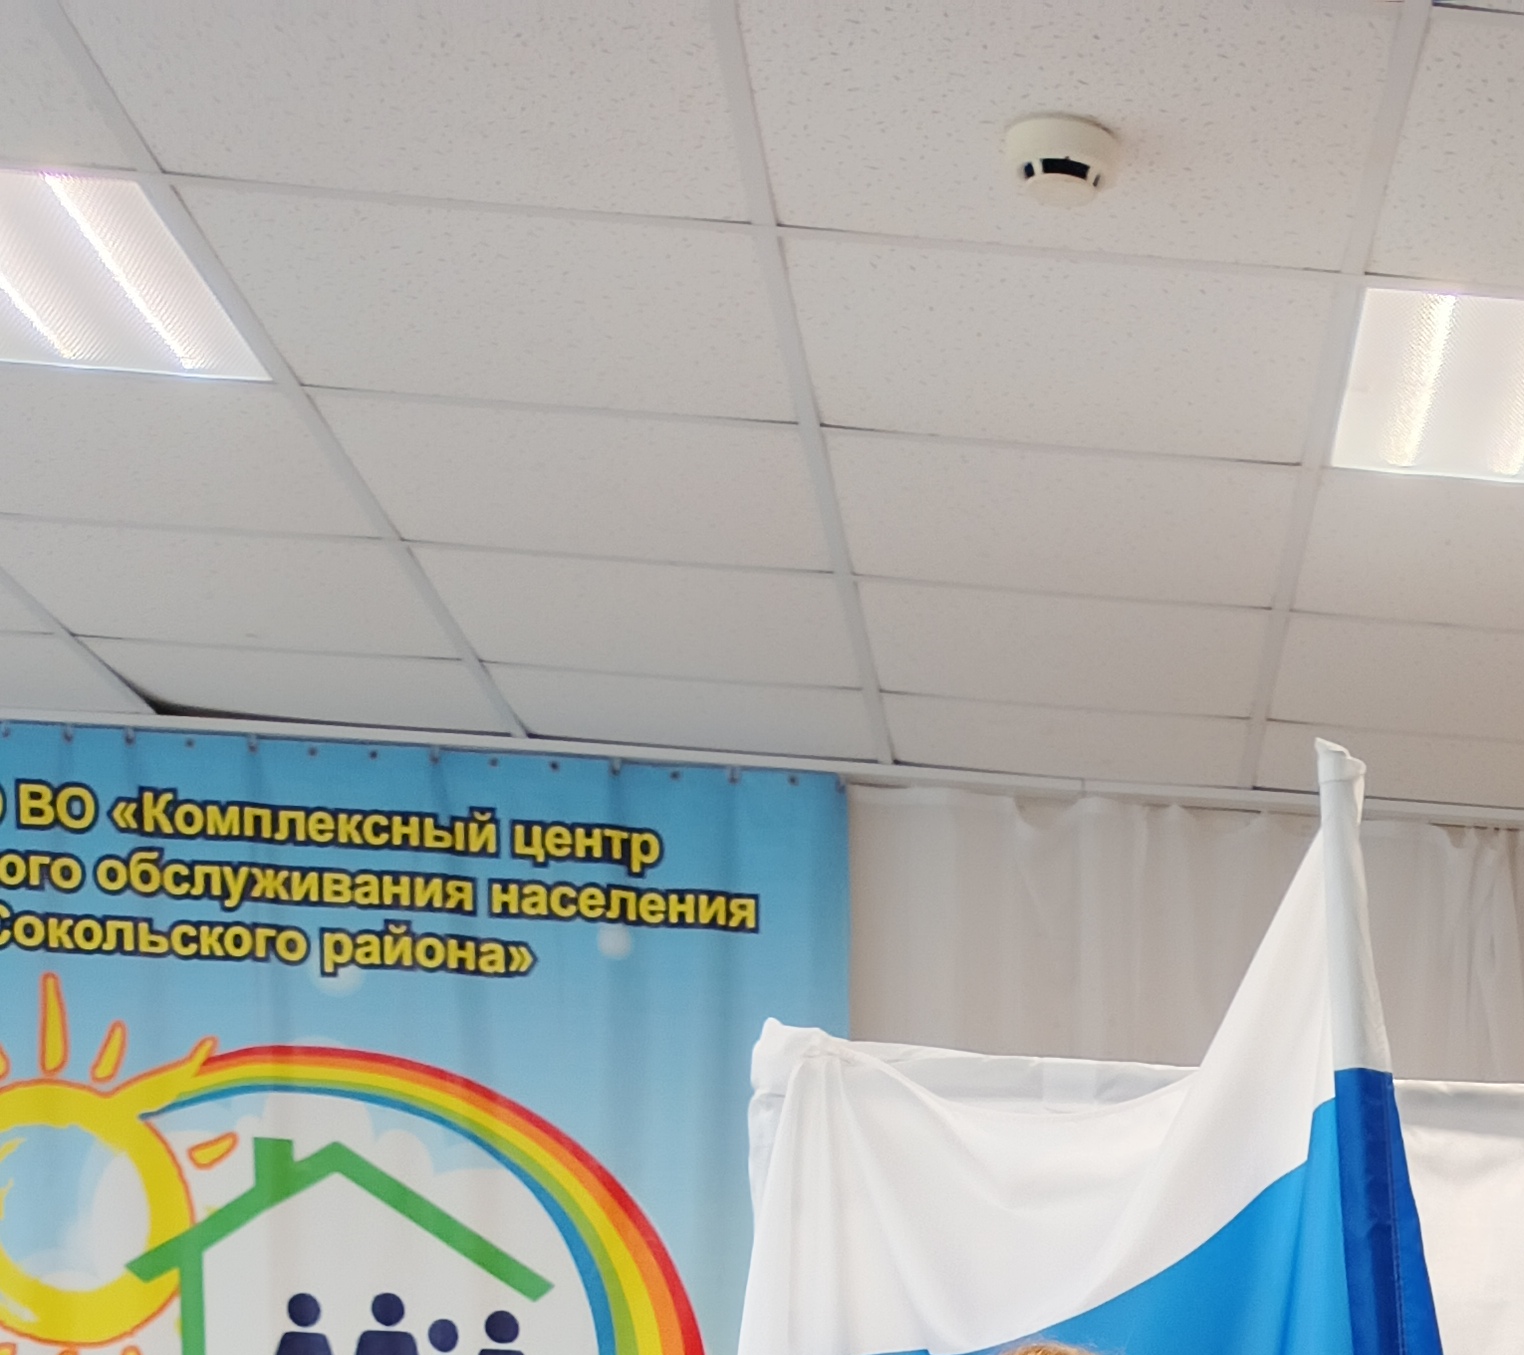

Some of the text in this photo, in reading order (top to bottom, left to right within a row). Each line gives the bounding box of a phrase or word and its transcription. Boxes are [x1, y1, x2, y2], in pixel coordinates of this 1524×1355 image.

[17, 782, 97, 831] ВО
[111, 791, 497, 855] «Комплексный
[512, 824, 662, 875] центр
[95, 849, 475, 912] обслуживания
[489, 883, 758, 930] населения
[322, 925, 533, 975] района»
